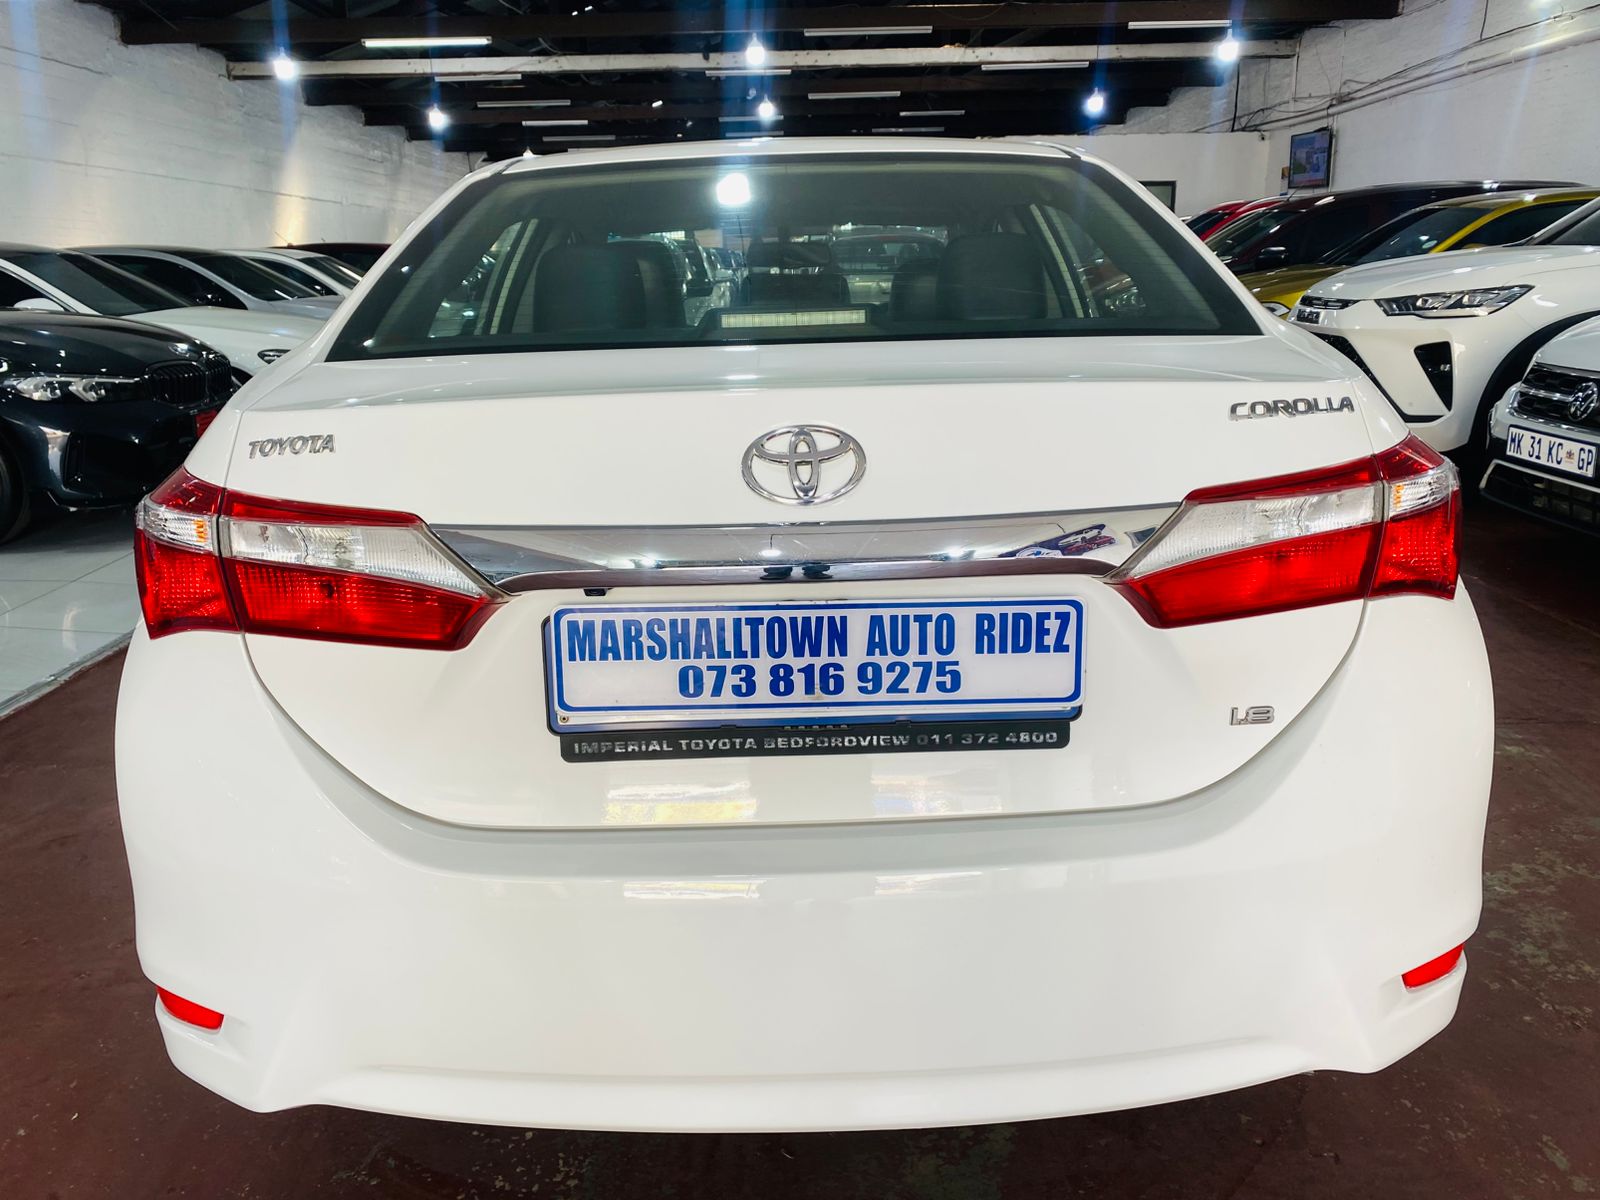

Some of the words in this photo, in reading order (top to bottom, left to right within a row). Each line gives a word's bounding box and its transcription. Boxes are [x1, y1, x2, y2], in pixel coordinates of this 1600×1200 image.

[1230, 396, 1355, 421] COROLLA
[248, 434, 335, 459] TOYOTA
[1508, 431, 1524, 455] MK
[1528, 436, 1542, 460] 31
[1547, 440, 1564, 465] KC
[1577, 447, 1594, 472] GP
[567, 614, 848, 662] MARSHALLTOWN
[866, 612, 955, 656] AUTO
[976, 610, 1071, 655] RIDEZ
[678, 663, 757, 699] 073
[769, 662, 844, 697] 816
[857, 660, 962, 695] 9275
[574, 740, 673, 754] IMPERIAL
[678, 737, 757, 751] TOYOTA
[764, 735, 910, 749] BEDFORDVIEW
[917, 734, 953, 745] 011
[961, 733, 999, 744] 372
[1005, 731, 1058, 744] 4800
